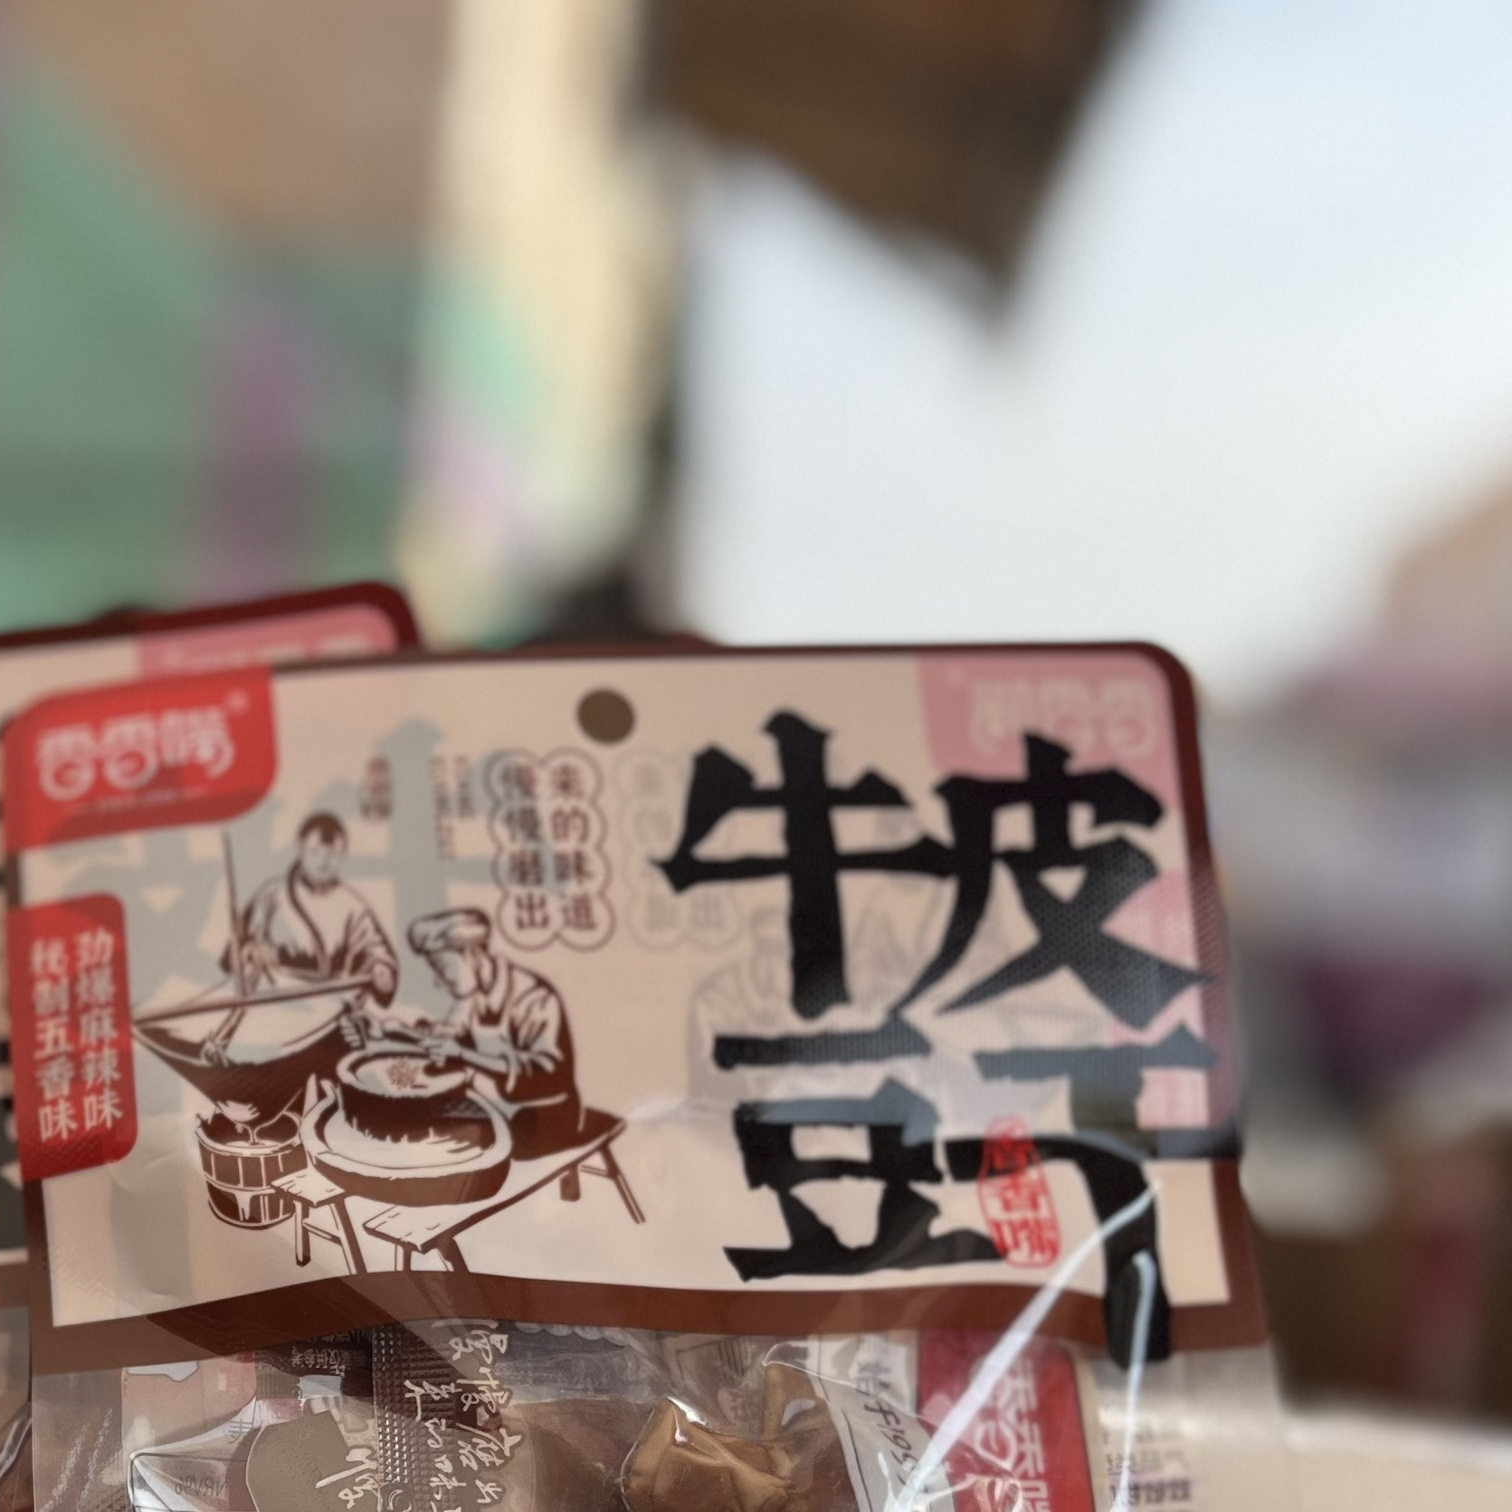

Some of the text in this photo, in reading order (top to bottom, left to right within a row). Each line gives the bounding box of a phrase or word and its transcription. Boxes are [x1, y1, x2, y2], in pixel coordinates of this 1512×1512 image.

[648, 707, 1218, 1030] 牛皮
[28, 937, 78, 1144] 秘制五香味
[73, 926, 125, 1132] 劲爆麻辣味
